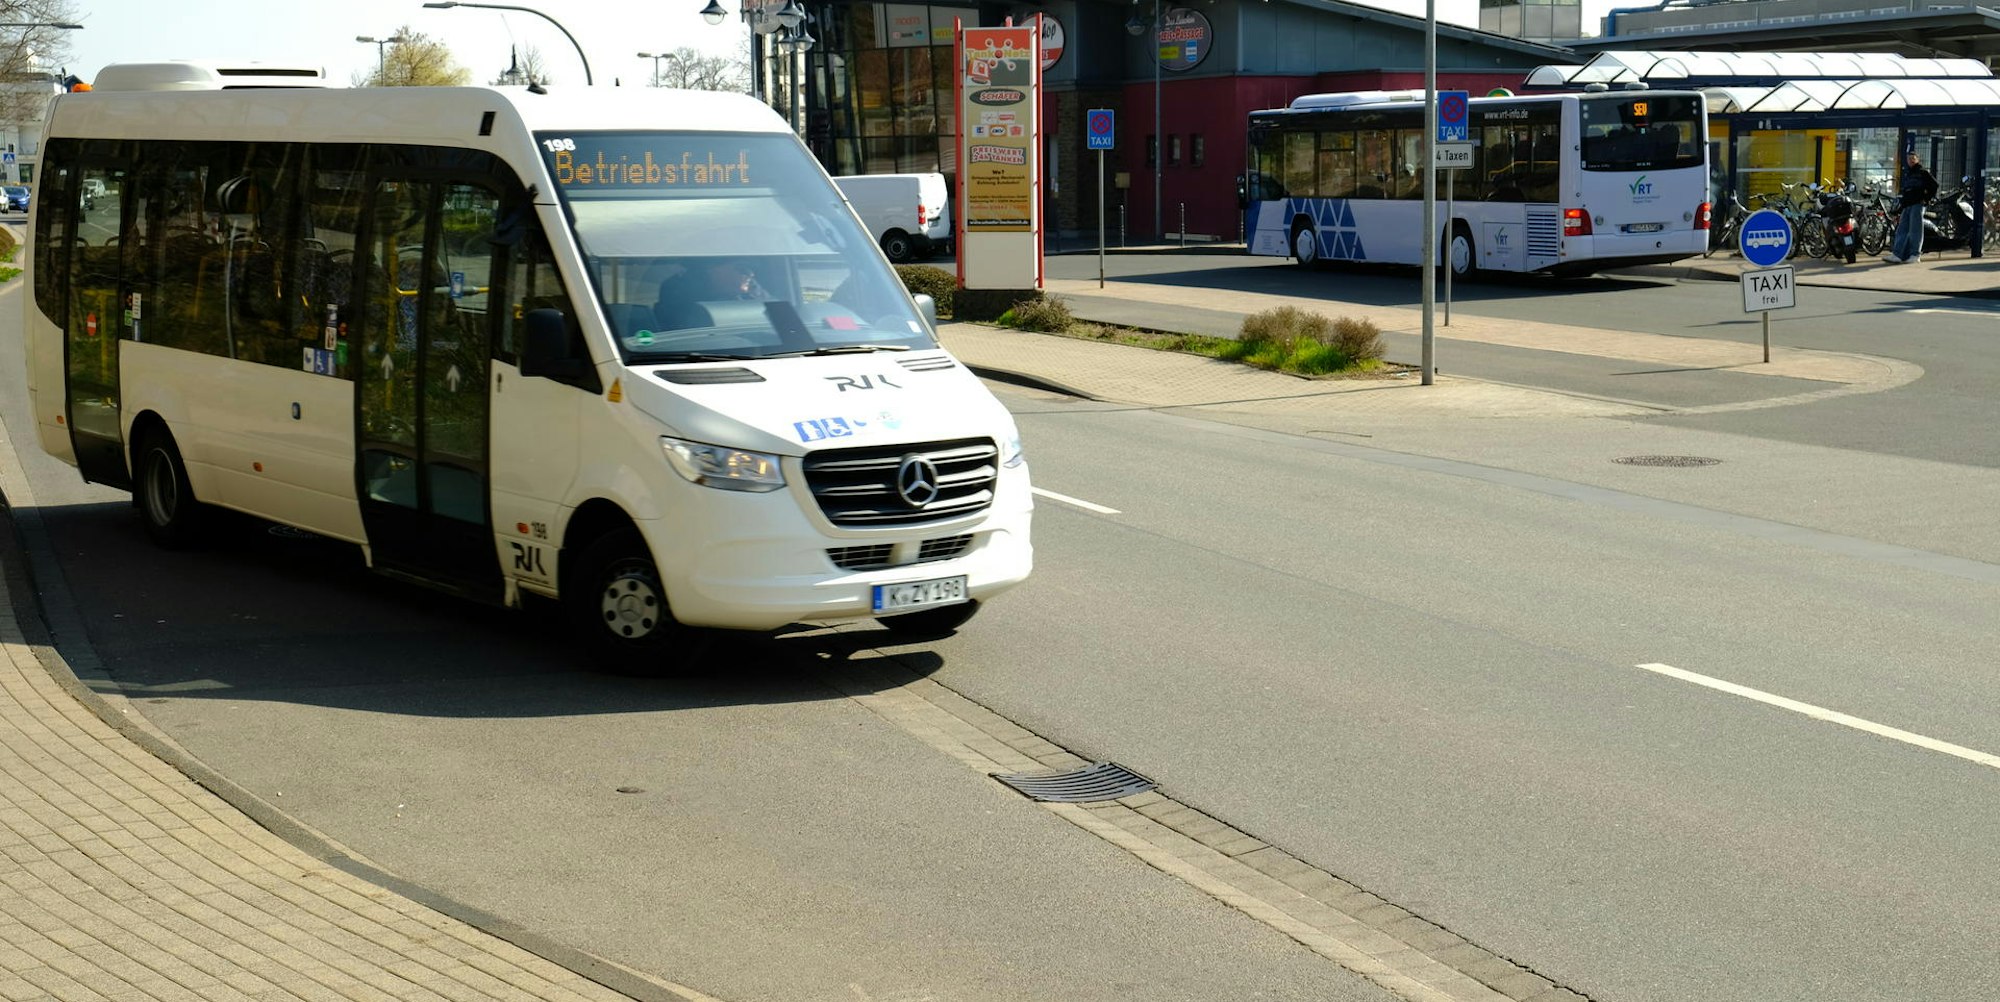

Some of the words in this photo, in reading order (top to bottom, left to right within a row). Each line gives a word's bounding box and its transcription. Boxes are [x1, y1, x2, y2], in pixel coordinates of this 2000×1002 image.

[1484, 108, 1529, 119] www.vrt-info.de
[1633, 102, 1648, 116] SEV
[1441, 126, 1465, 137] TAXI
[544, 138, 576, 152] 198
[1090, 136, 1112, 146] TAXI
[1444, 150, 1469, 161] Taxen
[554, 149, 750, 184] Betriebsfahrt
[1629, 175, 1653, 195] VRT
[1749, 273, 1788, 293] TAXI
[1762, 294, 1779, 305] frei
